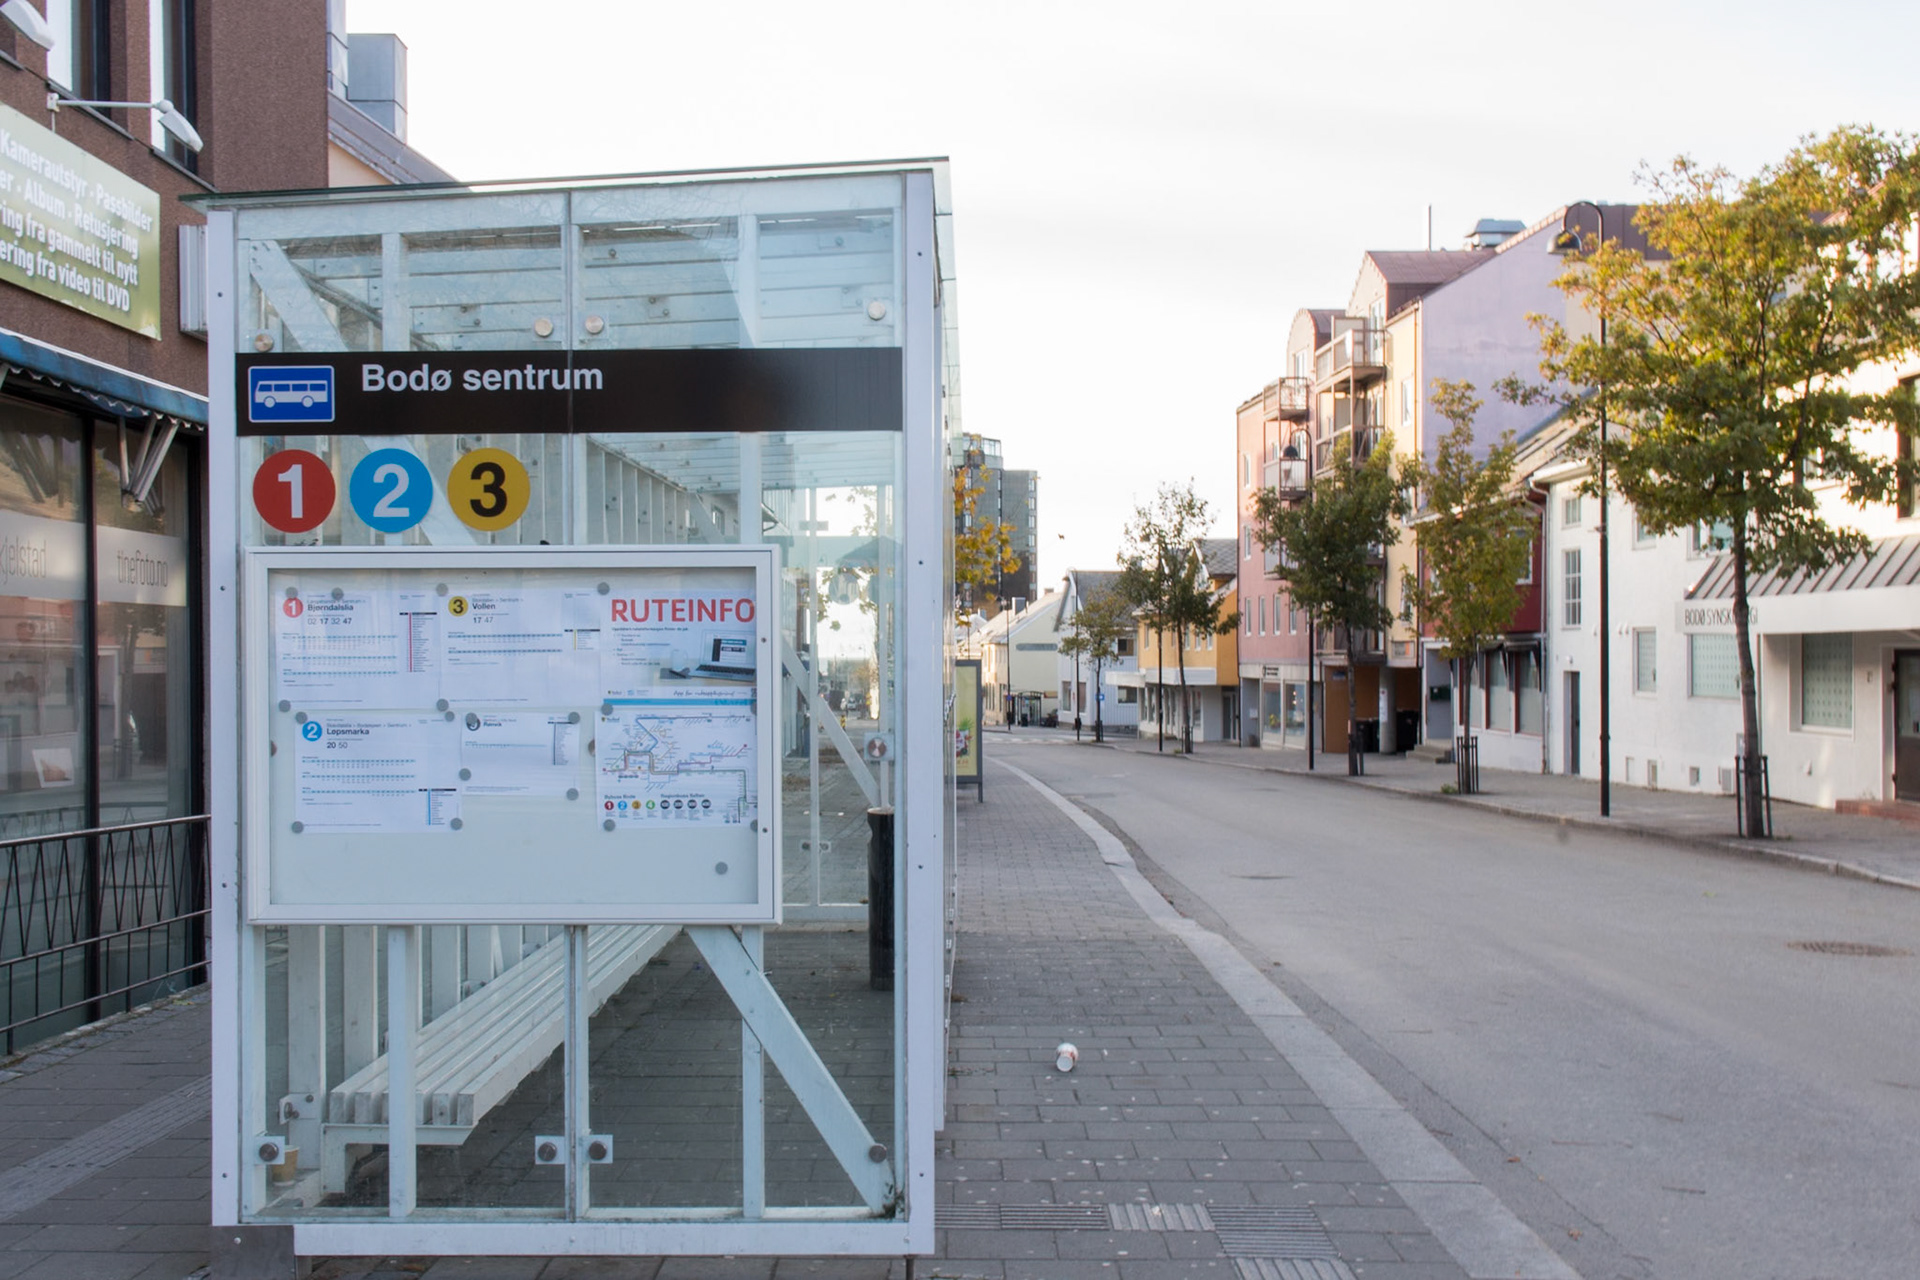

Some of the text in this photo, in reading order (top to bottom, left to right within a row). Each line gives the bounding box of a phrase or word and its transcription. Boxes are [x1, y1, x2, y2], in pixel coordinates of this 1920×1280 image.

[0, 129, 152, 232] Kamerautstyr Passbilder
[24, 178, 66, 219] Album
[74, 203, 139, 260] Retusjering
[0, 200, 138, 286] ing fra gammelt til nytt
[37, 251, 56, 282] fra
[58, 263, 90, 295] video
[92, 279, 105, 302] til
[107, 283, 130, 312] DVD
[362, 363, 603, 392] Bodø sentrum
[278, 464, 304, 519] 1
[372, 463, 410, 518] 2
[469, 462, 508, 518] 3
[117, 549, 168, 588] tinefoto.no
[288, 600, 297, 616] 1
[307, 604, 354, 613] Bjørndalslia
[452, 599, 464, 614] 3
[472, 602, 496, 610] Vollen
[611, 598, 755, 623] RUTEINFO
[473, 616, 482, 624] 17
[306, 723, 318, 739] 2
[326, 728, 370, 737] Løpsmarka
[326, 741, 348, 749] 20 50
